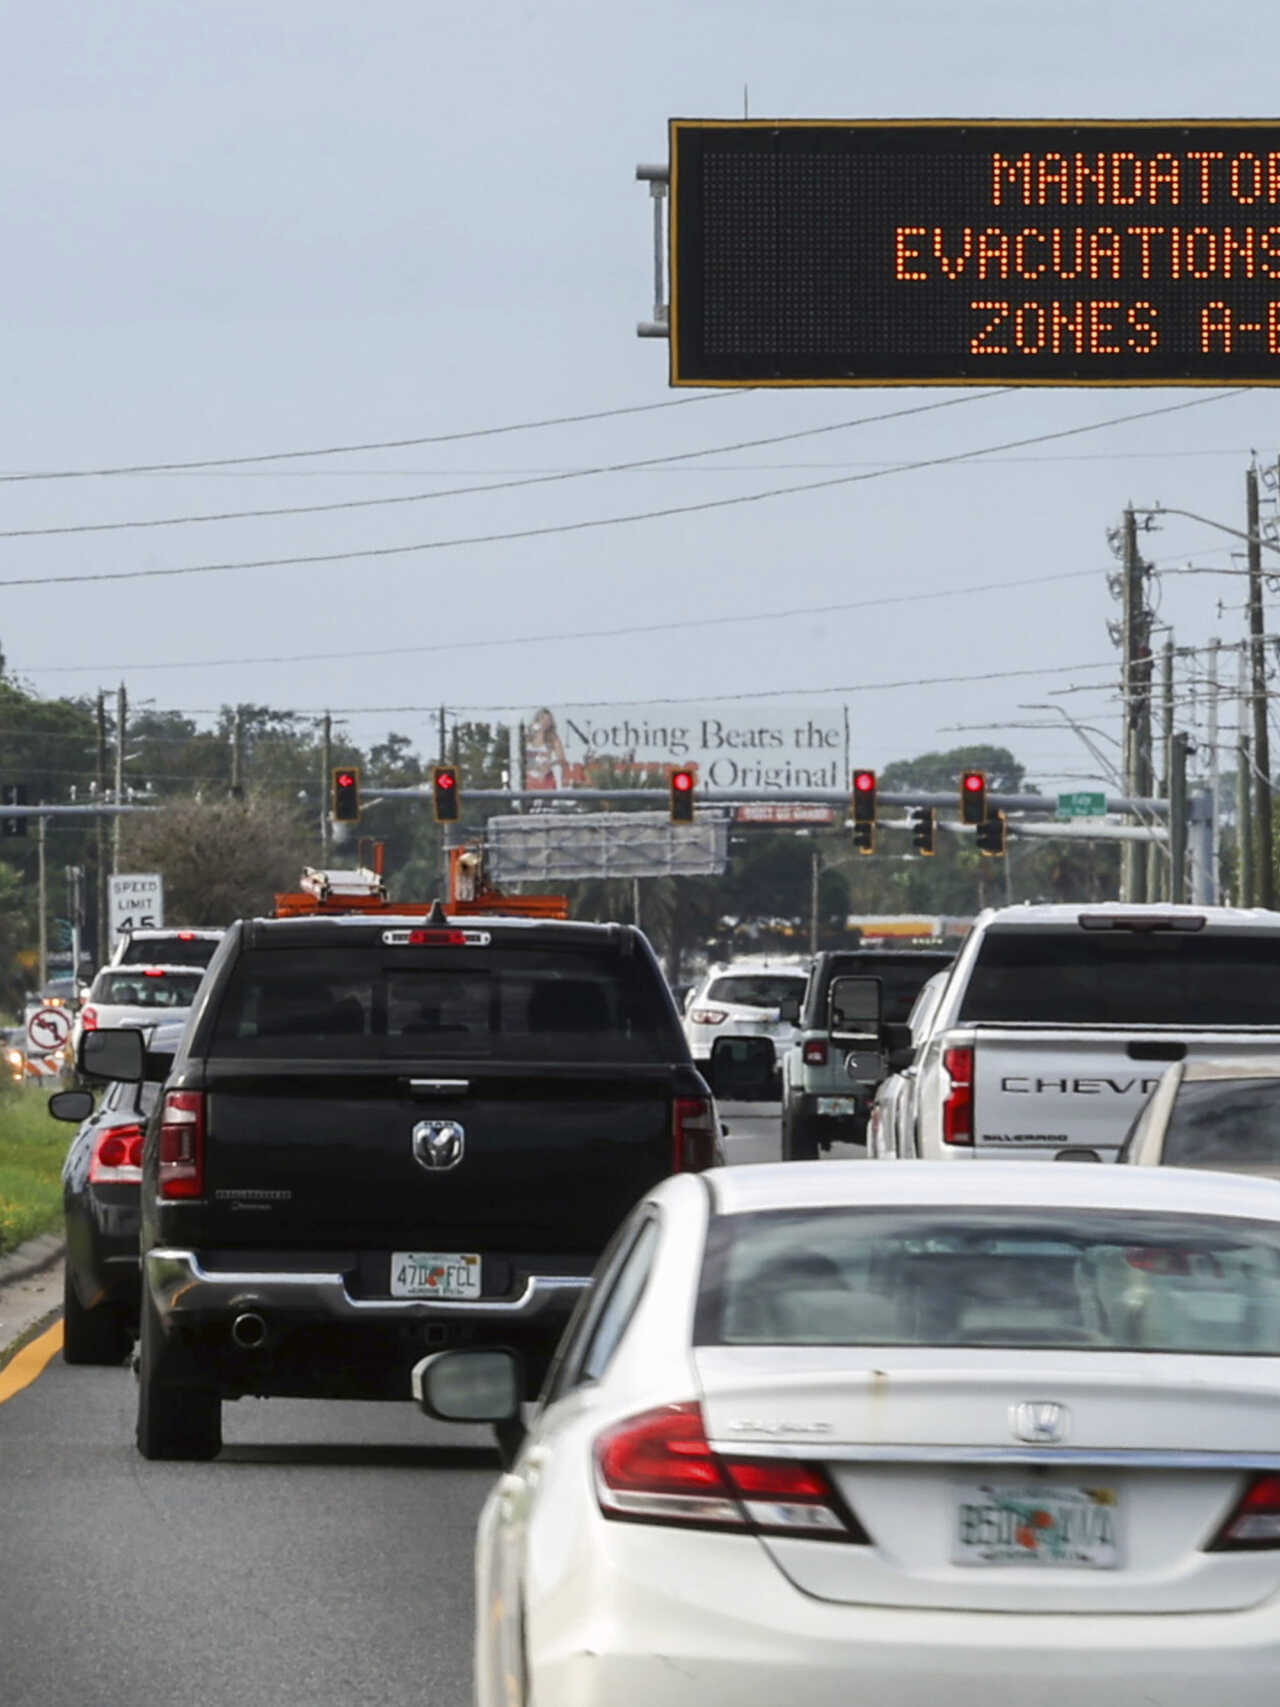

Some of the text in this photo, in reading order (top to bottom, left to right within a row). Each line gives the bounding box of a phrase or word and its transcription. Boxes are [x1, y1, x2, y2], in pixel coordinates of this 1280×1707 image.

[969, 301, 1158, 354] ZONES
[565, 719, 841, 757] Nothing Beats the
[708, 758, 838, 791] Original
[114, 880, 157, 894] SPEED
[118, 898, 152, 910] LIMIT
[982, 1134, 1068, 1142] SILVERADO
